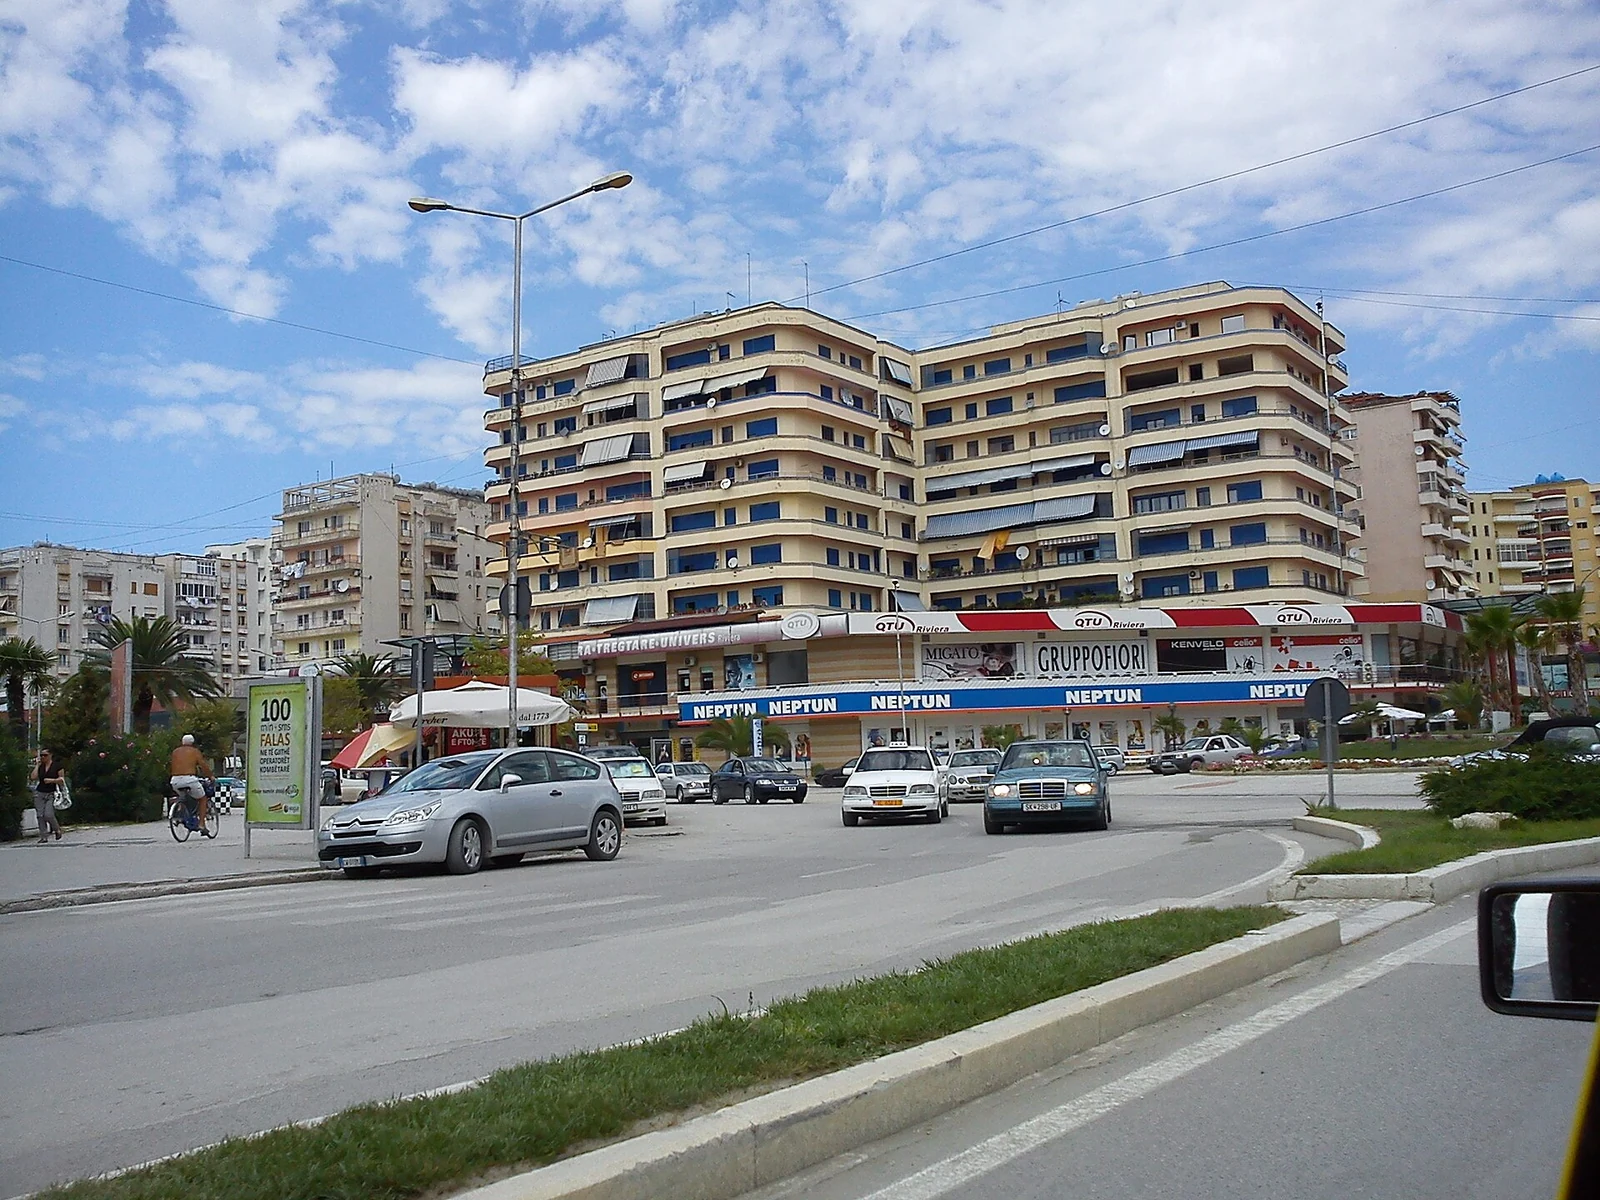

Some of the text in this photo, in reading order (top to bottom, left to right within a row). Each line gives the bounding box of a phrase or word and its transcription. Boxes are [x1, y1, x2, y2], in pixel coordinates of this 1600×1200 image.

[788, 619, 807, 630] QTU
[1075, 618, 1145, 629] QTU Riviera
[1277, 613, 1303, 623] QTU
[876, 622, 905, 631] QTU
[596, 639, 656, 654] TREGTARE
[660, 632, 716, 648] UNIVERS
[1171, 640, 1225, 649] KENVELO
[926, 647, 979, 660] MIGATO
[1038, 644, 1146, 672] GRUPPOFIORI
[1065, 688, 1142, 705] NEPTUN
[1249, 683, 1311, 699] NEPTU
[768, 697, 837, 715] NEPTUN
[871, 694, 951, 710] NEPTUN
[261, 698, 291, 722] 100
[518, 712, 550, 722] dal 1773
[260, 723, 274, 732] min
[278, 723, 291, 732] sms
[260, 732, 291, 747] FALAS
